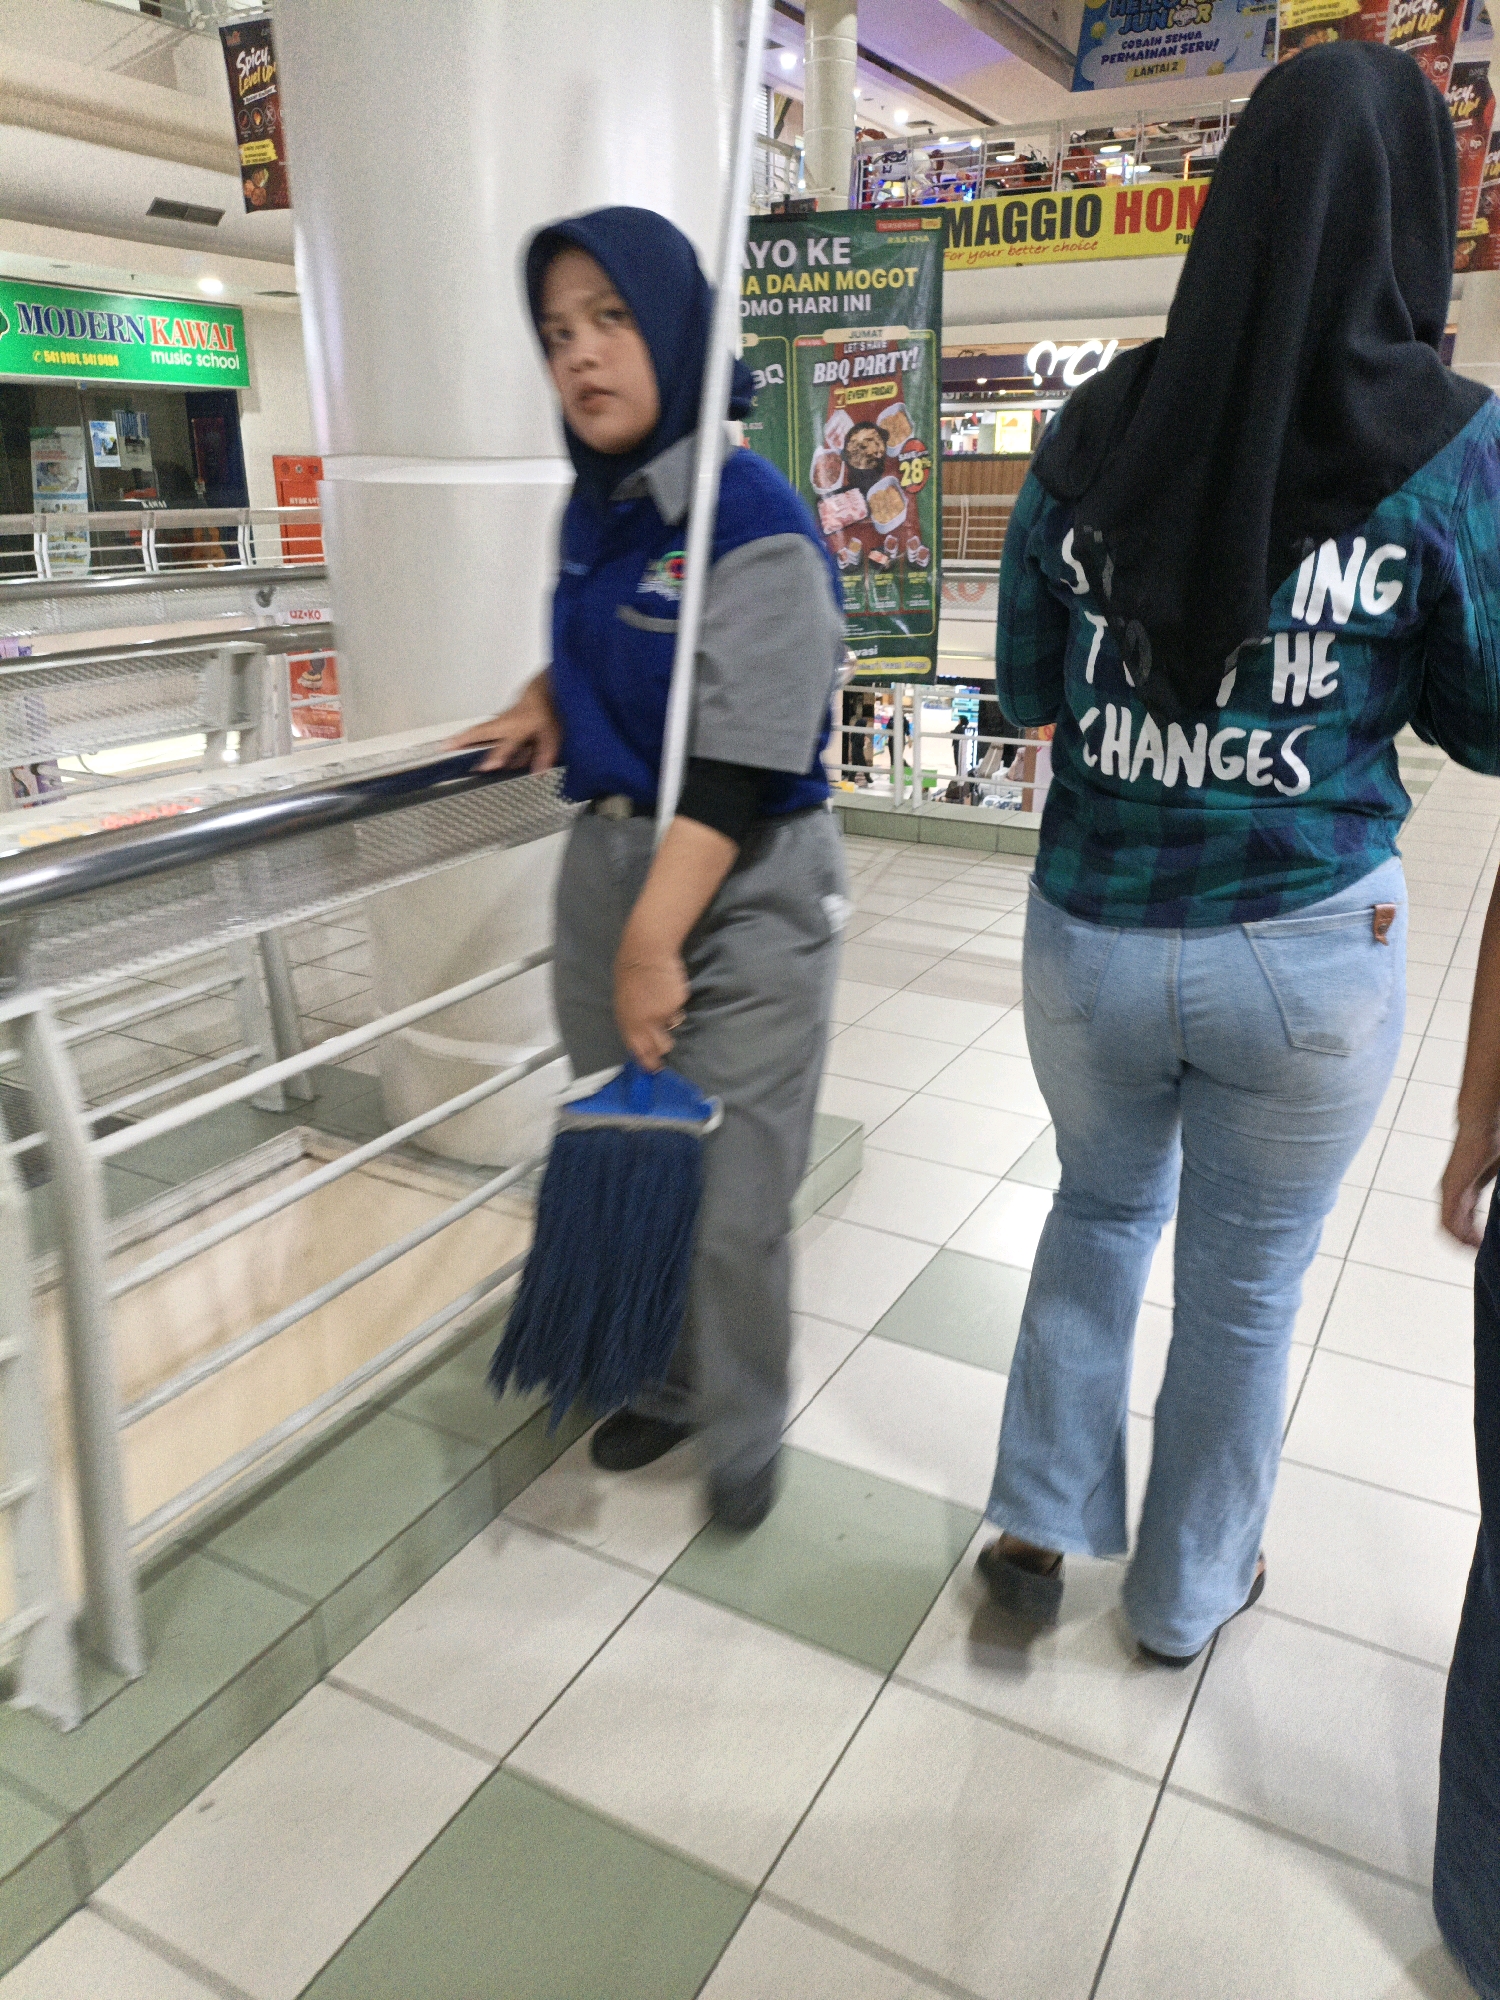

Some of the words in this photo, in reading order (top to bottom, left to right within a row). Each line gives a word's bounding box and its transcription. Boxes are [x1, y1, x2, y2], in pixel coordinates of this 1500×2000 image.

[1133, 63, 1170, 77] LANTAI
[943, 193, 1103, 248] MAGGIO
[807, 237, 851, 266] KE
[766, 272, 830, 294] DAAN
[836, 267, 918, 290] MOGOT
[788, 295, 838, 314] HARI
[843, 293, 871, 311] INI
[15, 302, 146, 344] MODERN
[148, 316, 237, 352] KAWAI
[151, 350, 192, 366] music
[196, 353, 240, 370] school
[812, 358, 851, 386] BBQ
[852, 346, 920, 378] PARTY!
[1079, 702, 1316, 797] CHANGES
